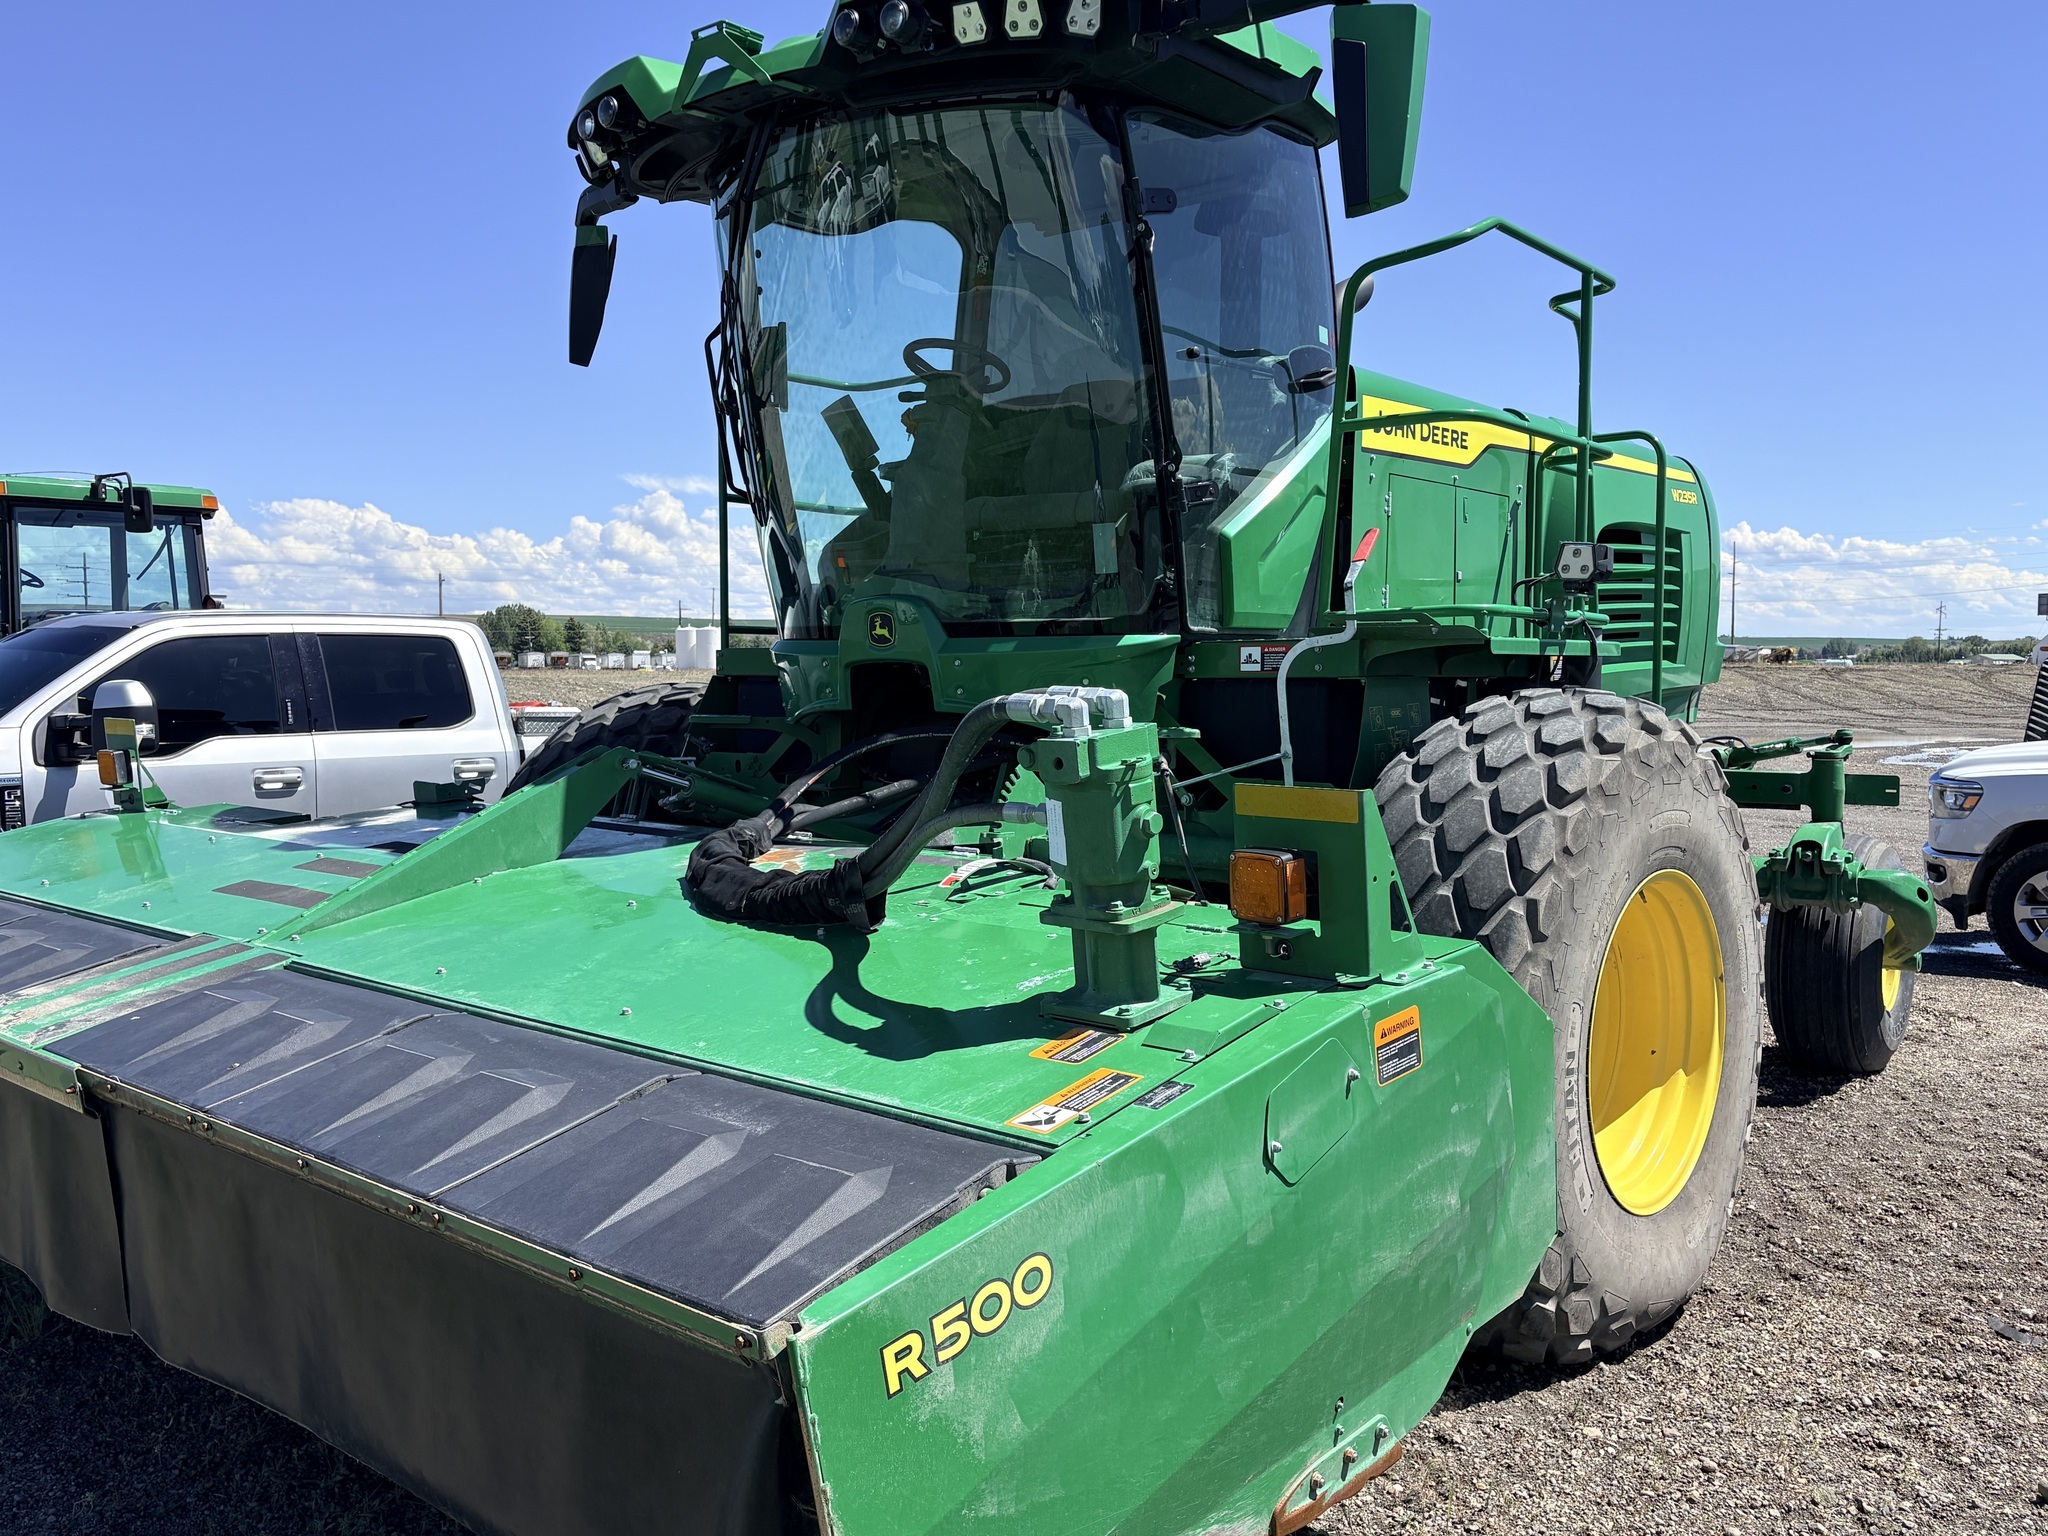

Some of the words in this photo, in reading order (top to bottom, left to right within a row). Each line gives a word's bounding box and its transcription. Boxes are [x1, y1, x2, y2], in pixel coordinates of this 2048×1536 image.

[1420, 421, 1469, 450] DEERE
[1671, 488, 1698, 504] W235R
[1386, 1016, 1415, 1036] WARNING
[879, 1329, 933, 1400] R
[928, 1251, 1055, 1367] 500
